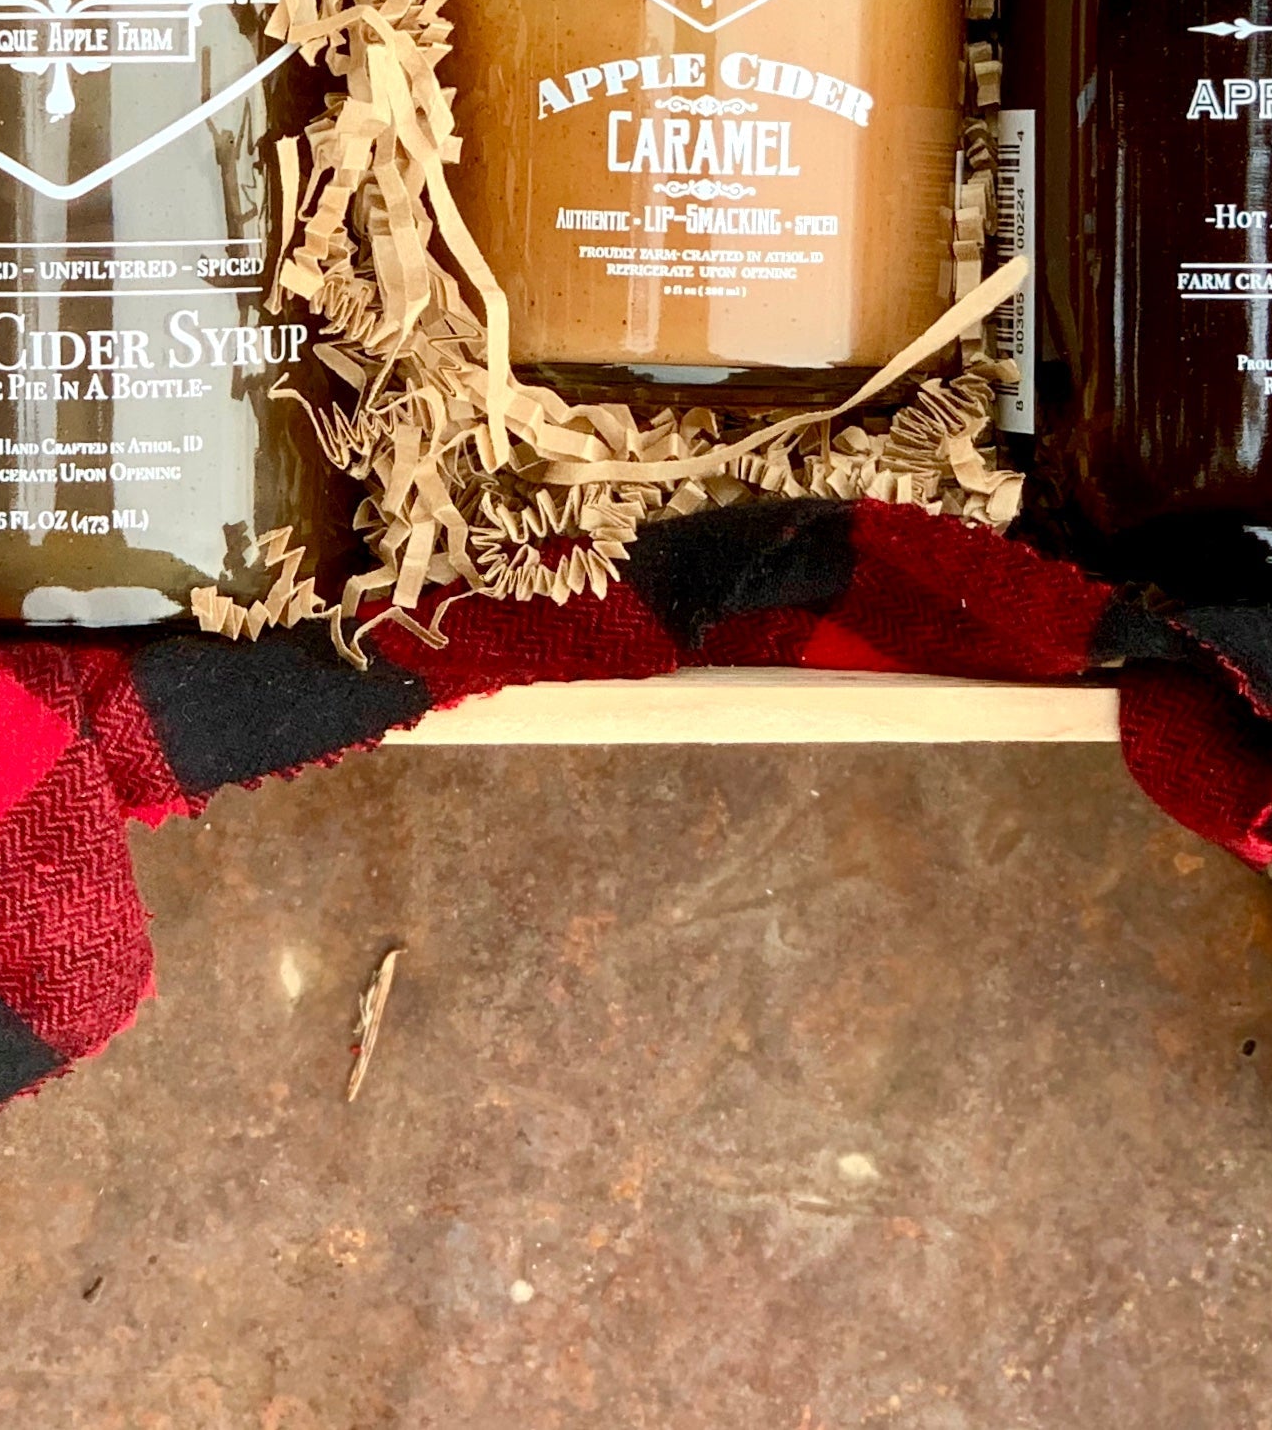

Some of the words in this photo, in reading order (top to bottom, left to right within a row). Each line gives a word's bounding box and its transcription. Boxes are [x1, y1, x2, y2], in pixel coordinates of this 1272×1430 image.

[48, 23, 108, 53] APPLE
[117, 23, 173, 52] FARM
[537, 52, 706, 120] APPLE
[721, 52, 875, 128] CIDER
[607, 110, 801, 177] CARAMEL
[1016, 130, 1025, 142] 4
[556, 207, 630, 231] AUTHENTIC
[644, 204, 781, 235] LIP-SMACKING
[794, 216, 838, 236] SPICED
[1205, 205, 1267, 229] -HOT
[39, 259, 177, 280] UNFILTERED
[197, 257, 264, 277] SPICED
[1177, 273, 1231, 290] FARM
[168, 309, 308, 368] SYRUP
[9, 374, 48, 400] PIE
[52, 375, 79, 399] IN
[84, 377, 108, 399] A
[114, 374, 212, 399] BOTTLE-
[42, 438, 107, 456] CRAFTED
[183, 435, 203, 453] ID
[60, 464, 107, 483] UPON
[11, 513, 35, 532] FL
[37, 512, 67, 532] OZ
[71, 512, 109, 535] (473
[112, 511, 149, 532] ML)
